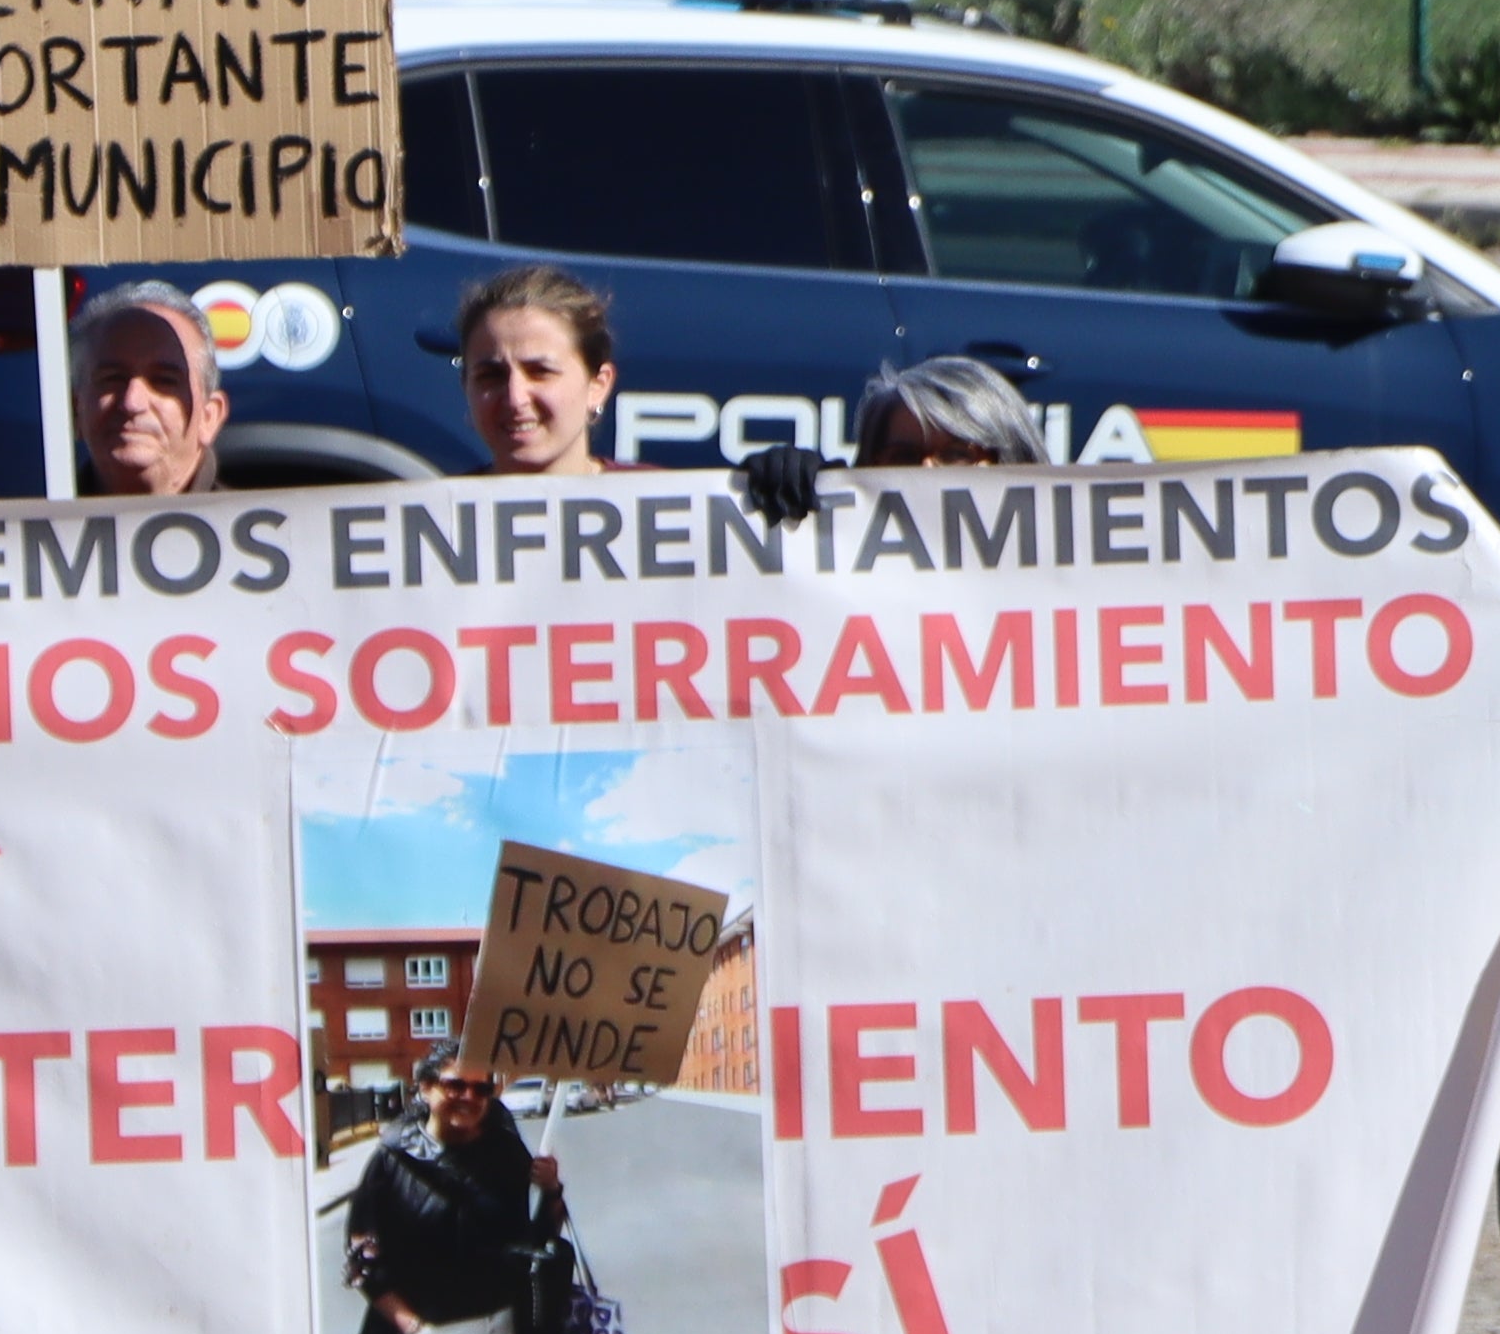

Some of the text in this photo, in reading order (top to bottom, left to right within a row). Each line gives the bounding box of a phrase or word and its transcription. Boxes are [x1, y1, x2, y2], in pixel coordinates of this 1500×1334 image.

[616, 392, 1156, 466] POLIA
[333, 471, 1469, 588] ENFRENTAMIENTOS
[266, 592, 1474, 737] SOTERRAMIENTO
[498, 863, 717, 956] TROBAJO
[527, 944, 676, 1011] NO SE
[491, 1015, 656, 1075] RINDE
